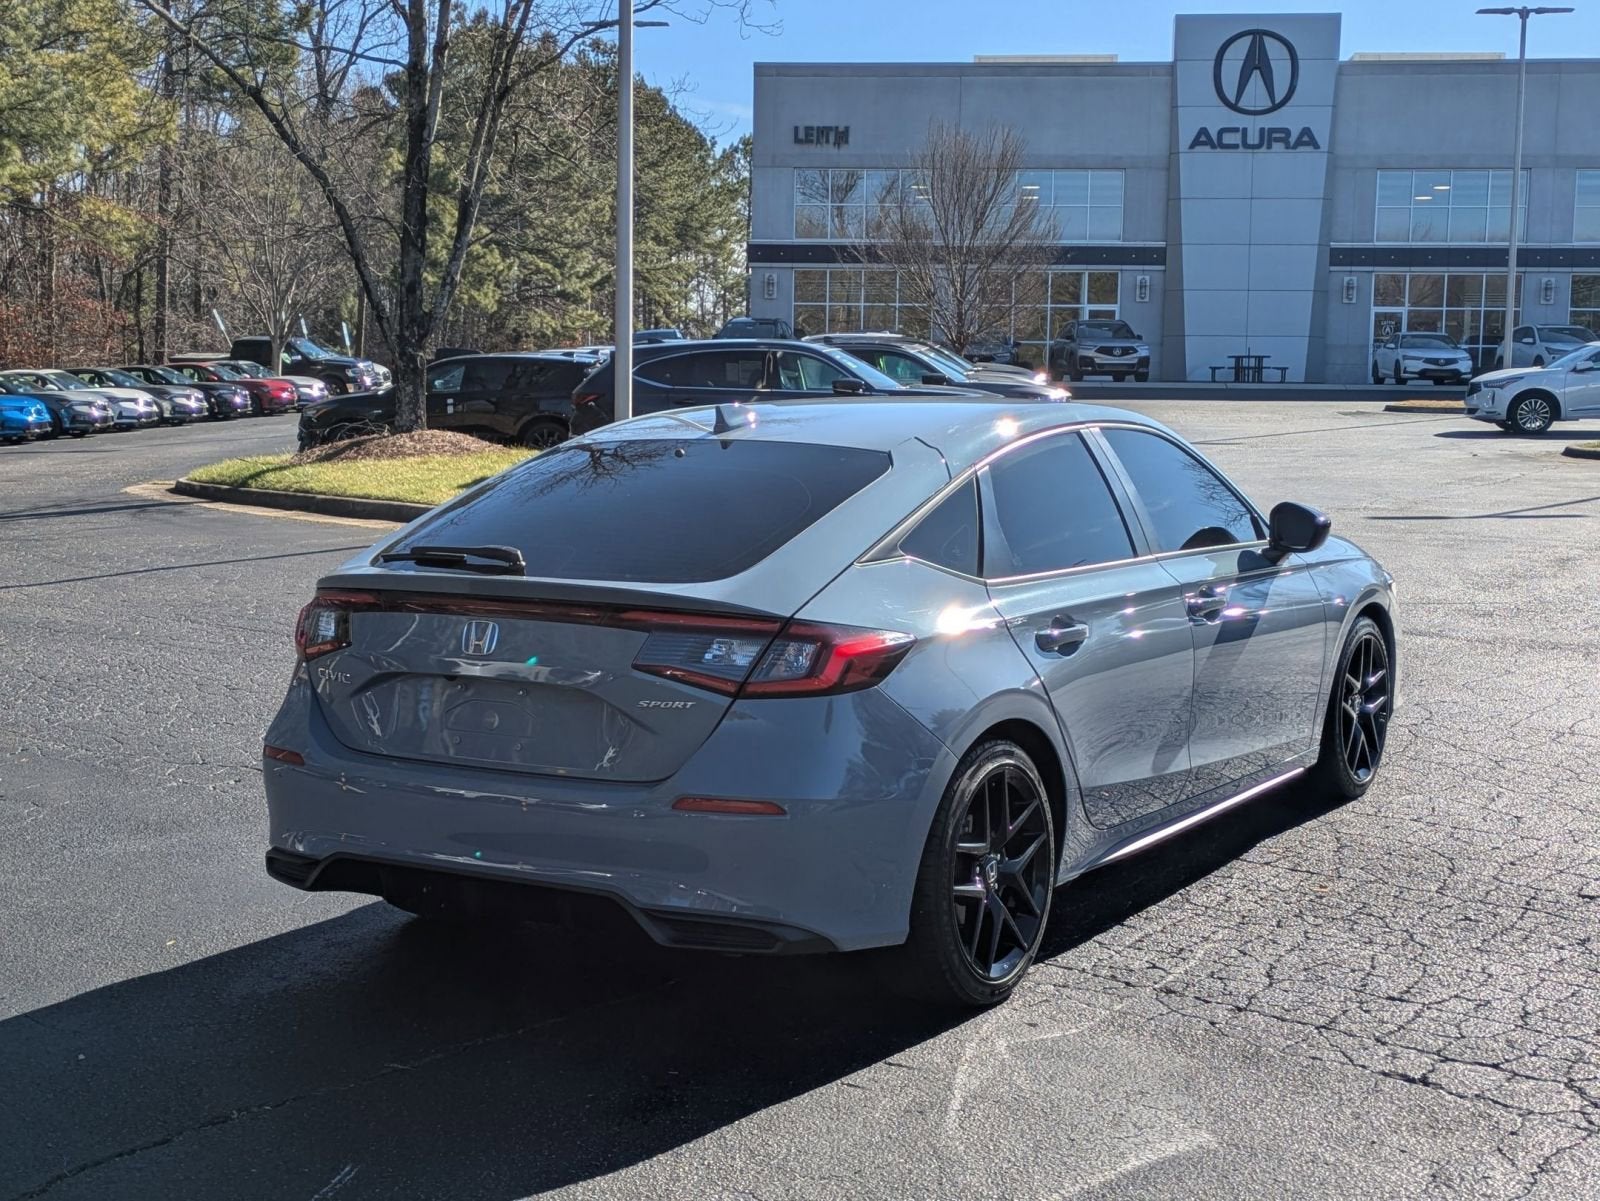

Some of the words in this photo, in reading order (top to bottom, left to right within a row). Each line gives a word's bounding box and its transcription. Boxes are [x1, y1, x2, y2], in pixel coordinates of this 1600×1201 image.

[793, 125, 850, 145] LEITH
[1188, 126, 1321, 150] ACURA
[318, 667, 351, 684] CIVIC
[637, 700, 697, 709] SPORT
